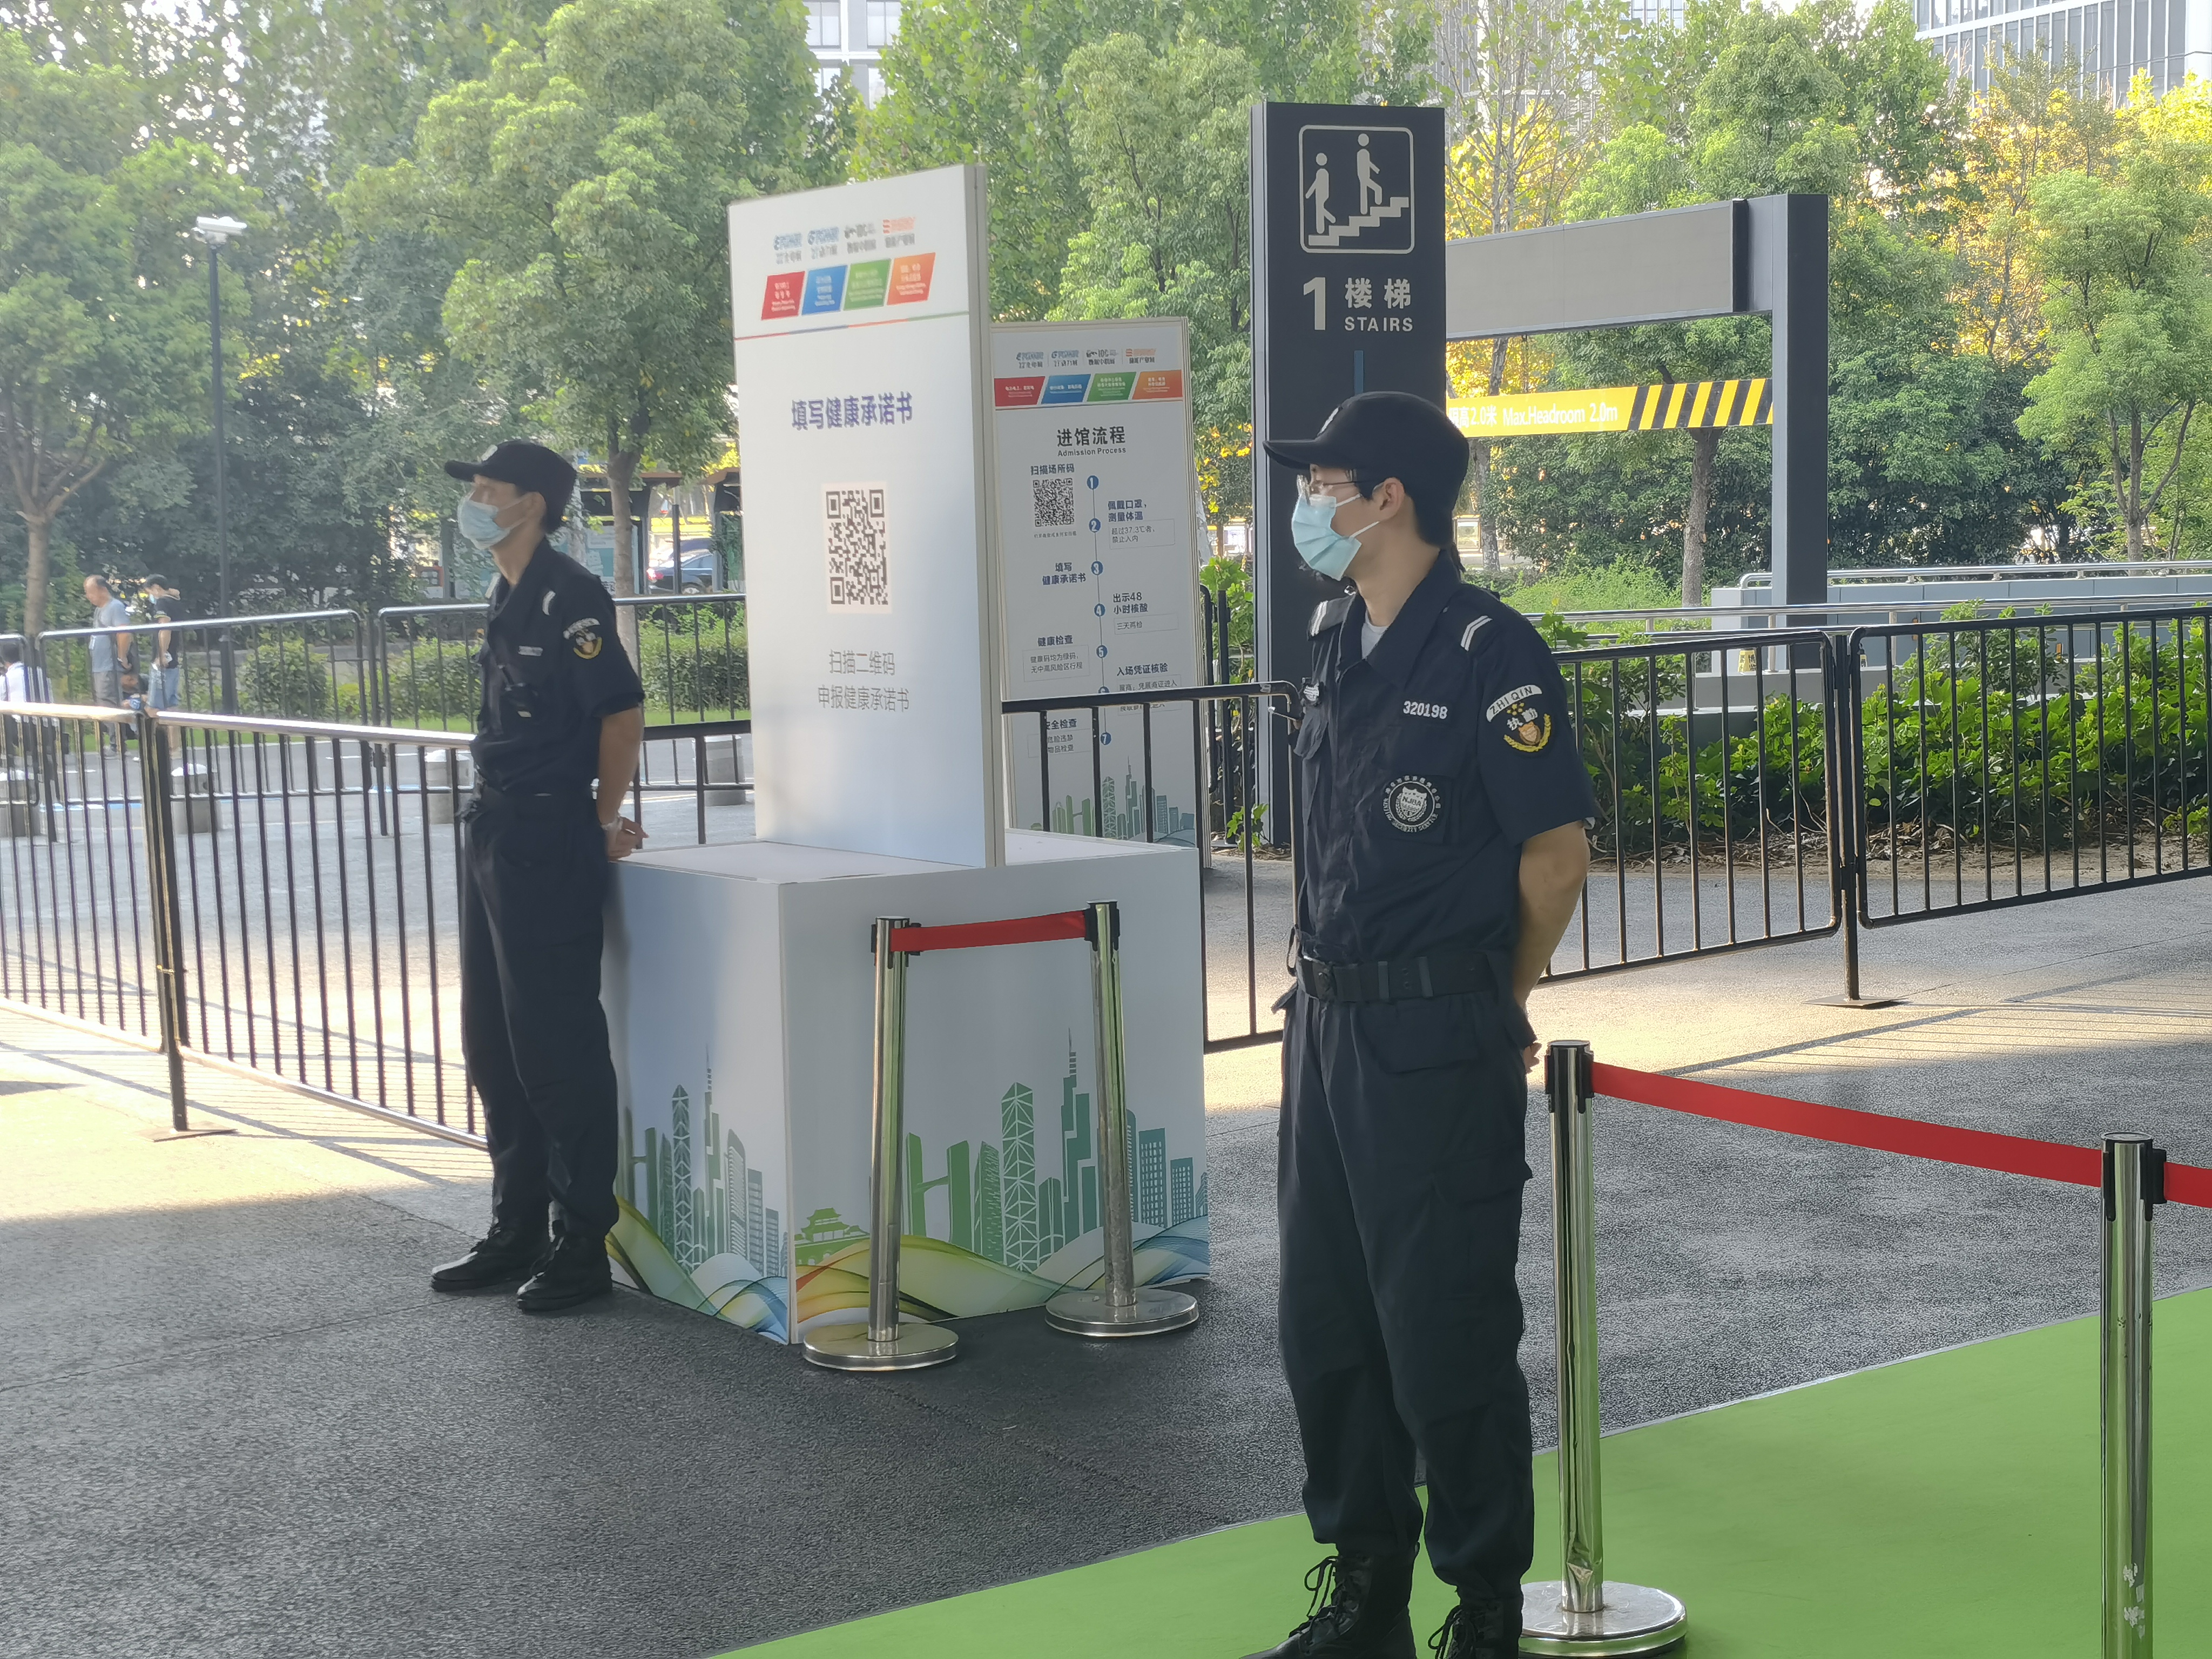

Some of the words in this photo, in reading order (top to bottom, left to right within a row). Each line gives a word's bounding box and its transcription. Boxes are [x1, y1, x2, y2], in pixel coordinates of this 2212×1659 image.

[1344, 277, 1412, 309] 楼梯
[1303, 276, 1326, 331] 1
[1344, 316, 1413, 332] STAIRS
[791, 391, 913, 430] 填写健康承诺书
[1449, 404, 1498, 428] 限高2.0米
[1502, 403, 1586, 426] Max.Headroom
[1589, 401, 1618, 423] 2.0m
[1057, 426, 1126, 447] 进馆流程
[1030, 463, 1075, 475] 扫描场所码
[1108, 511, 1143, 522] 测量体温
[1112, 535, 1138, 543] 禁止入内
[1055, 562, 1072, 572] 填写
[1042, 572, 1086, 585] 健康承诺书
[1113, 592, 1143, 603] 出示48
[1114, 603, 1149, 615] 小时核酸
[1037, 635, 1073, 646] 健康检查
[829, 649, 895, 675] 扫描二维码
[1116, 663, 1168, 676] 入场凭证核验
[818, 684, 909, 712] 申报健康承诺书
[1402, 700, 1448, 719] 320198
